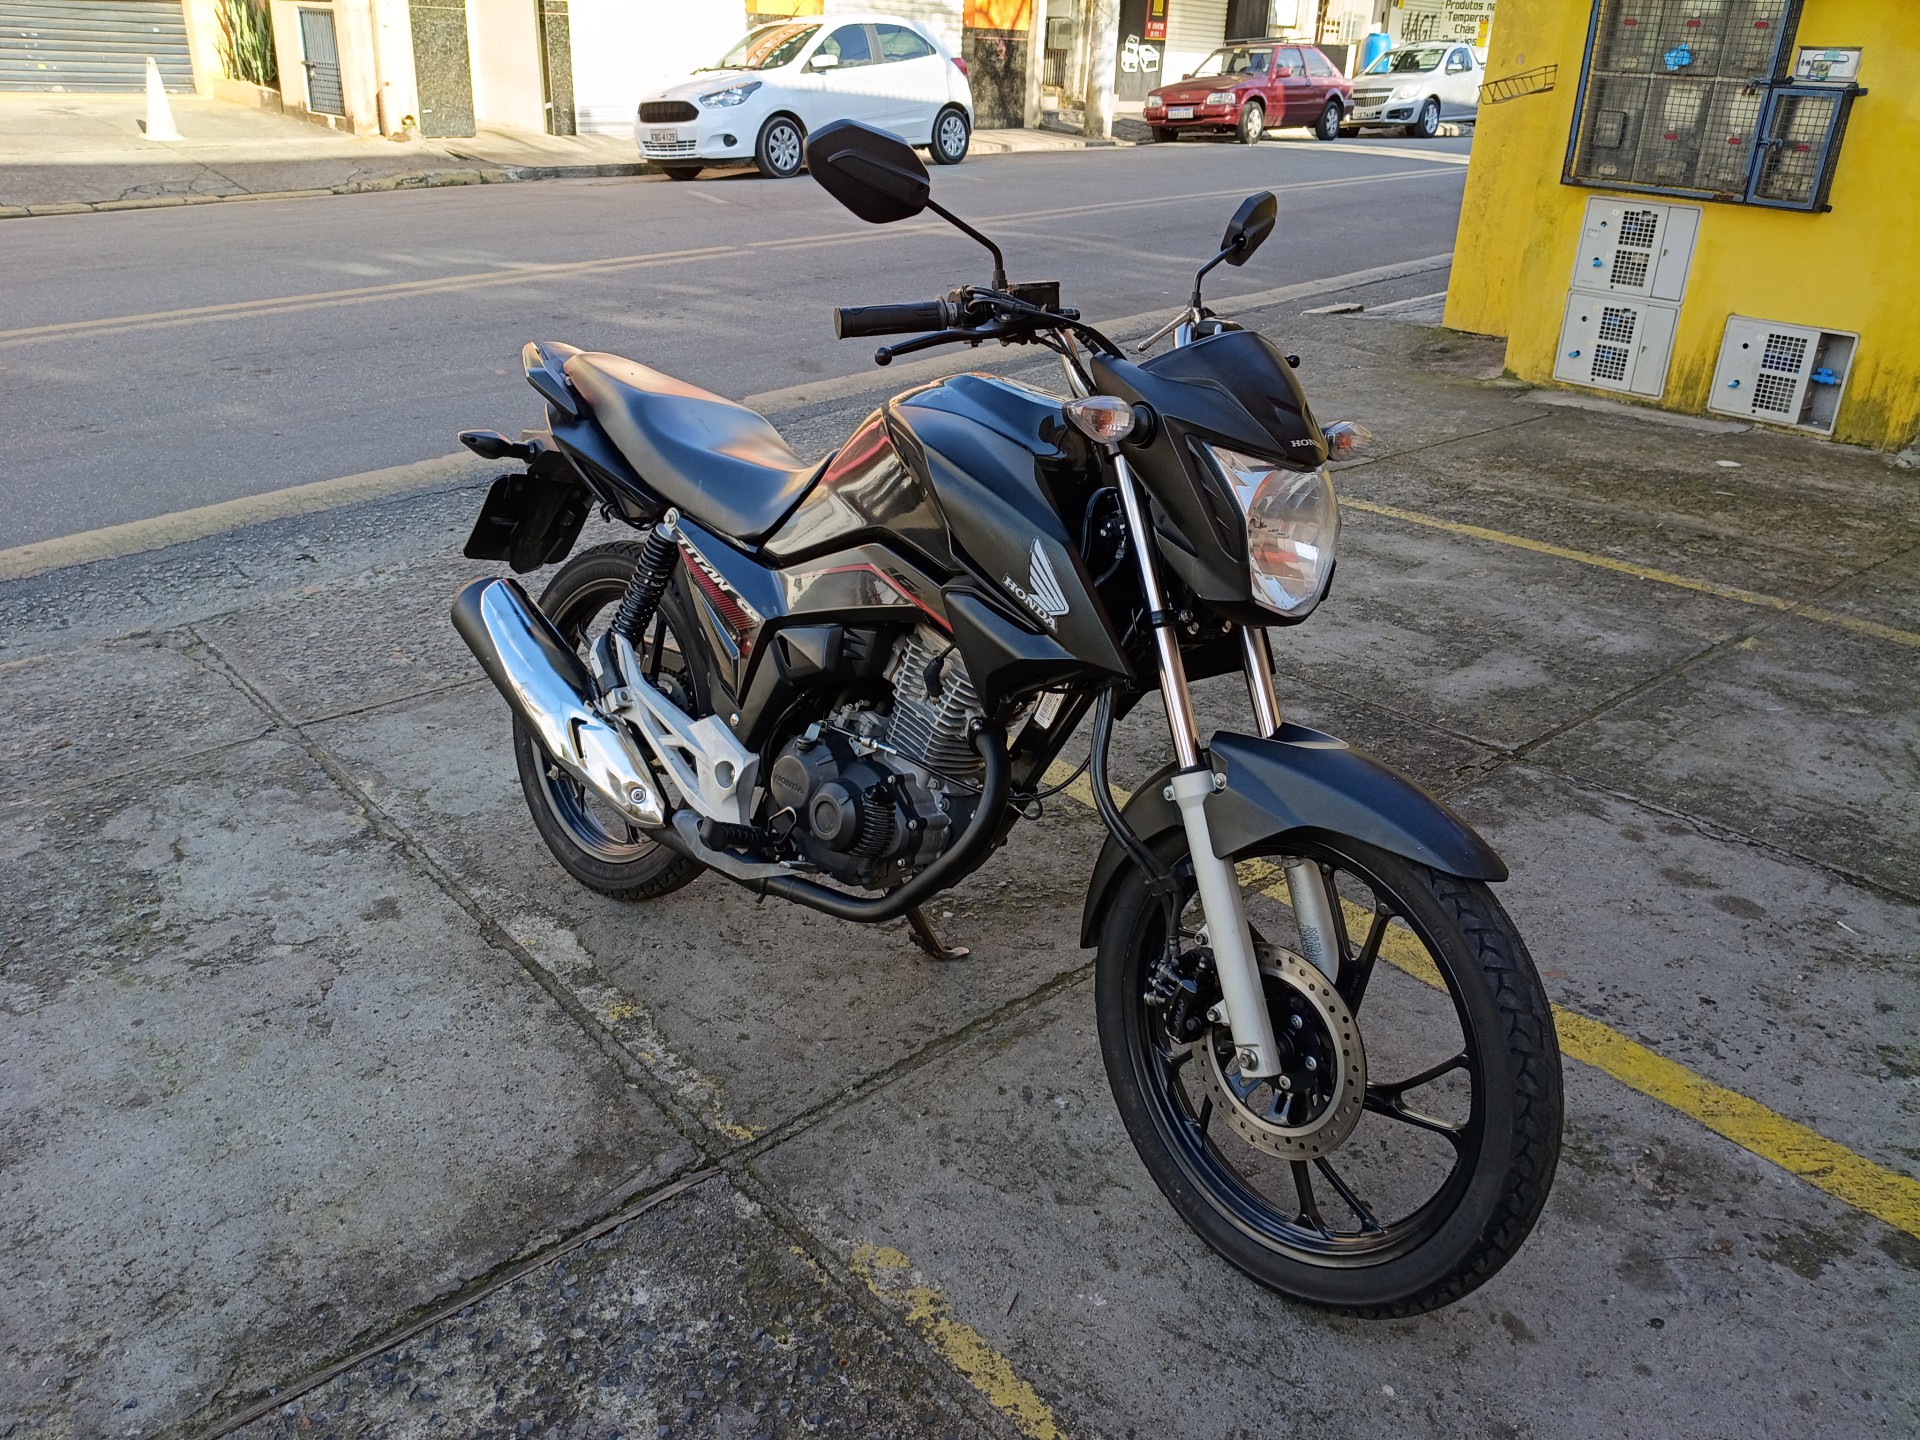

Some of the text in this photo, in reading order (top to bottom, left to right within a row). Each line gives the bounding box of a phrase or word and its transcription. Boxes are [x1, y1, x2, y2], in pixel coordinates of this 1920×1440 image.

[1445, 0, 1484, 11] Produtos
[1448, 11, 1490, 23] Temperos
[677, 533, 732, 592] TITAN
[1003, 575, 1057, 631] HONDA
[774, 773, 804, 794] HONDA
